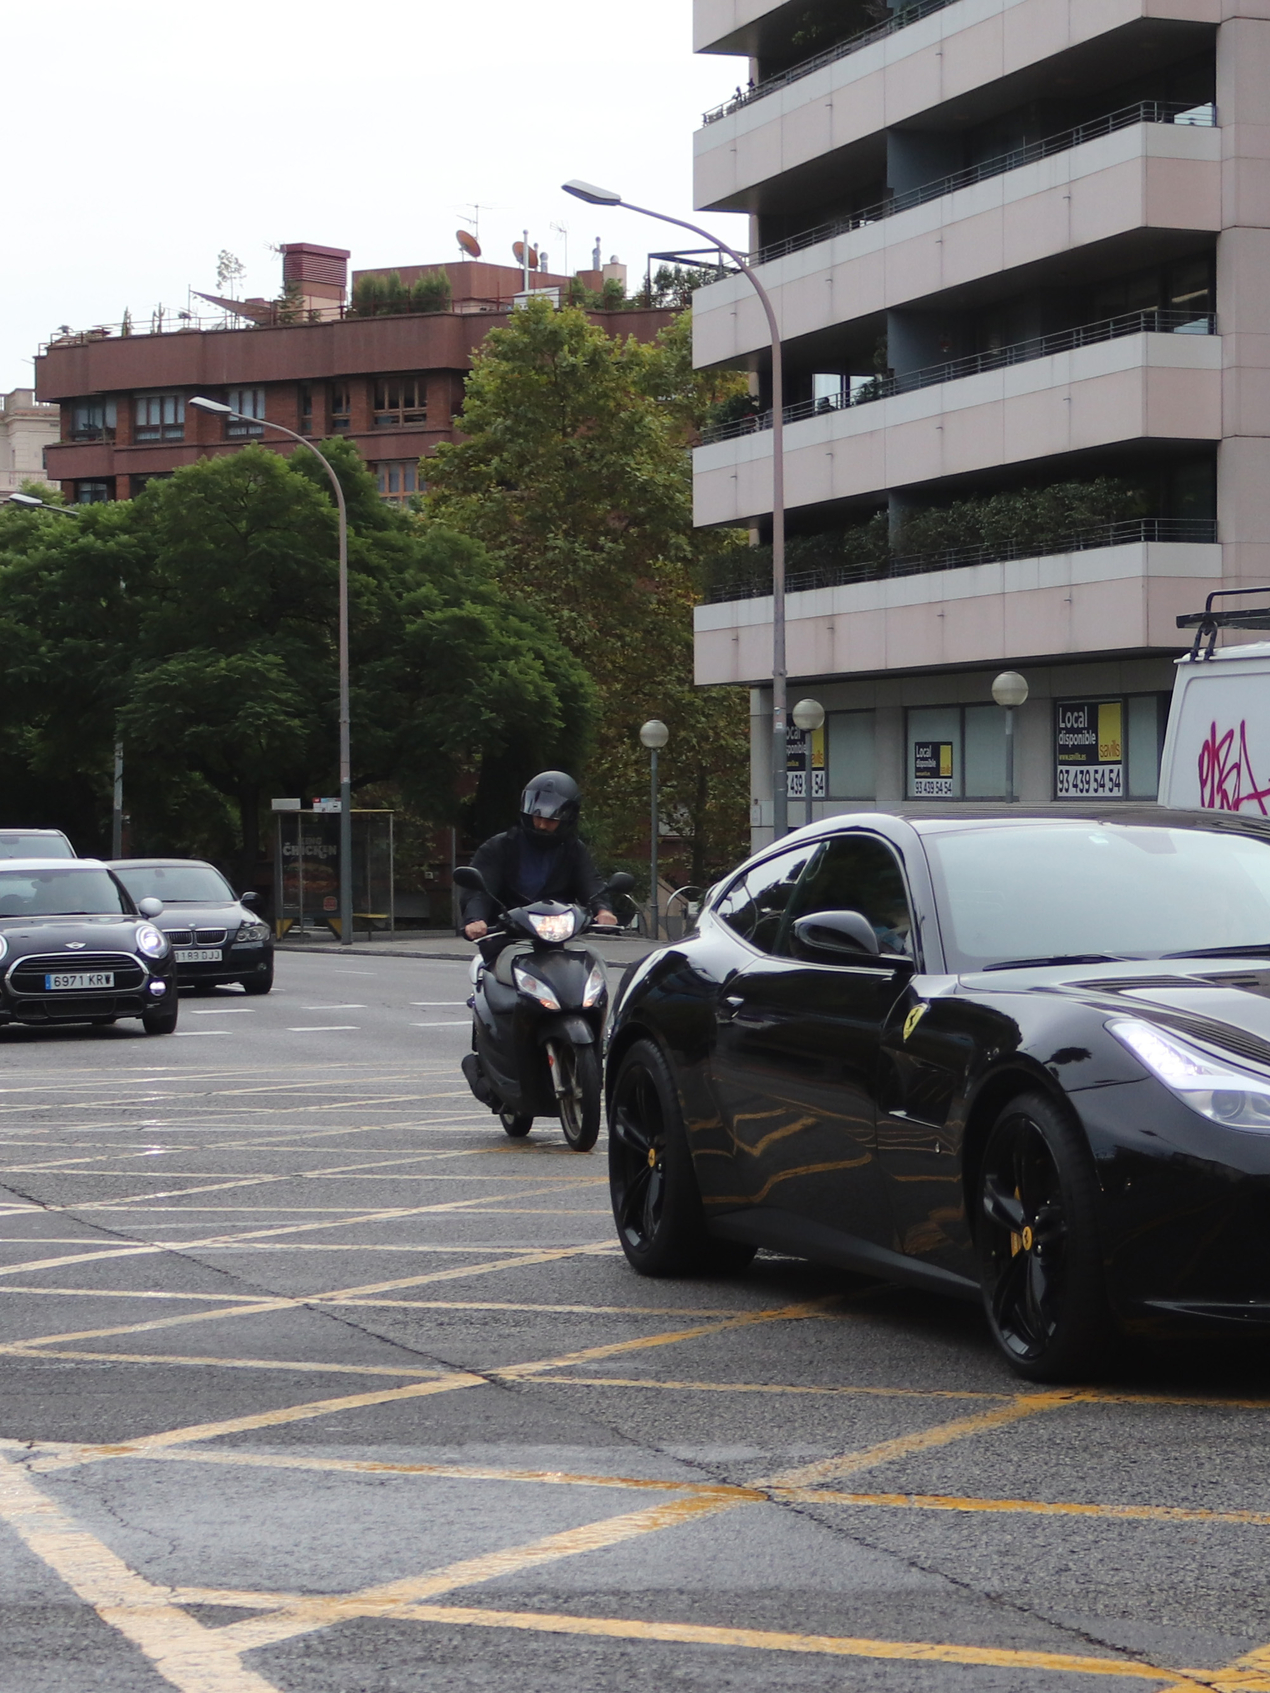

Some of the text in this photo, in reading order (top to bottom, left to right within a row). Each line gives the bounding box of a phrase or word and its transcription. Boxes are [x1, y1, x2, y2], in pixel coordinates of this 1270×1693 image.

[1059, 706, 1088, 728] Local
[786, 726, 801, 740] ocal
[1058, 730, 1096, 748] disponible
[916, 745, 932, 758] Local
[1100, 740, 1120, 758] savills
[915, 781, 952, 794] 93 439 54 54
[1058, 768, 1121, 794] 93 439 54 54
[54, 975, 84, 987] 6971
